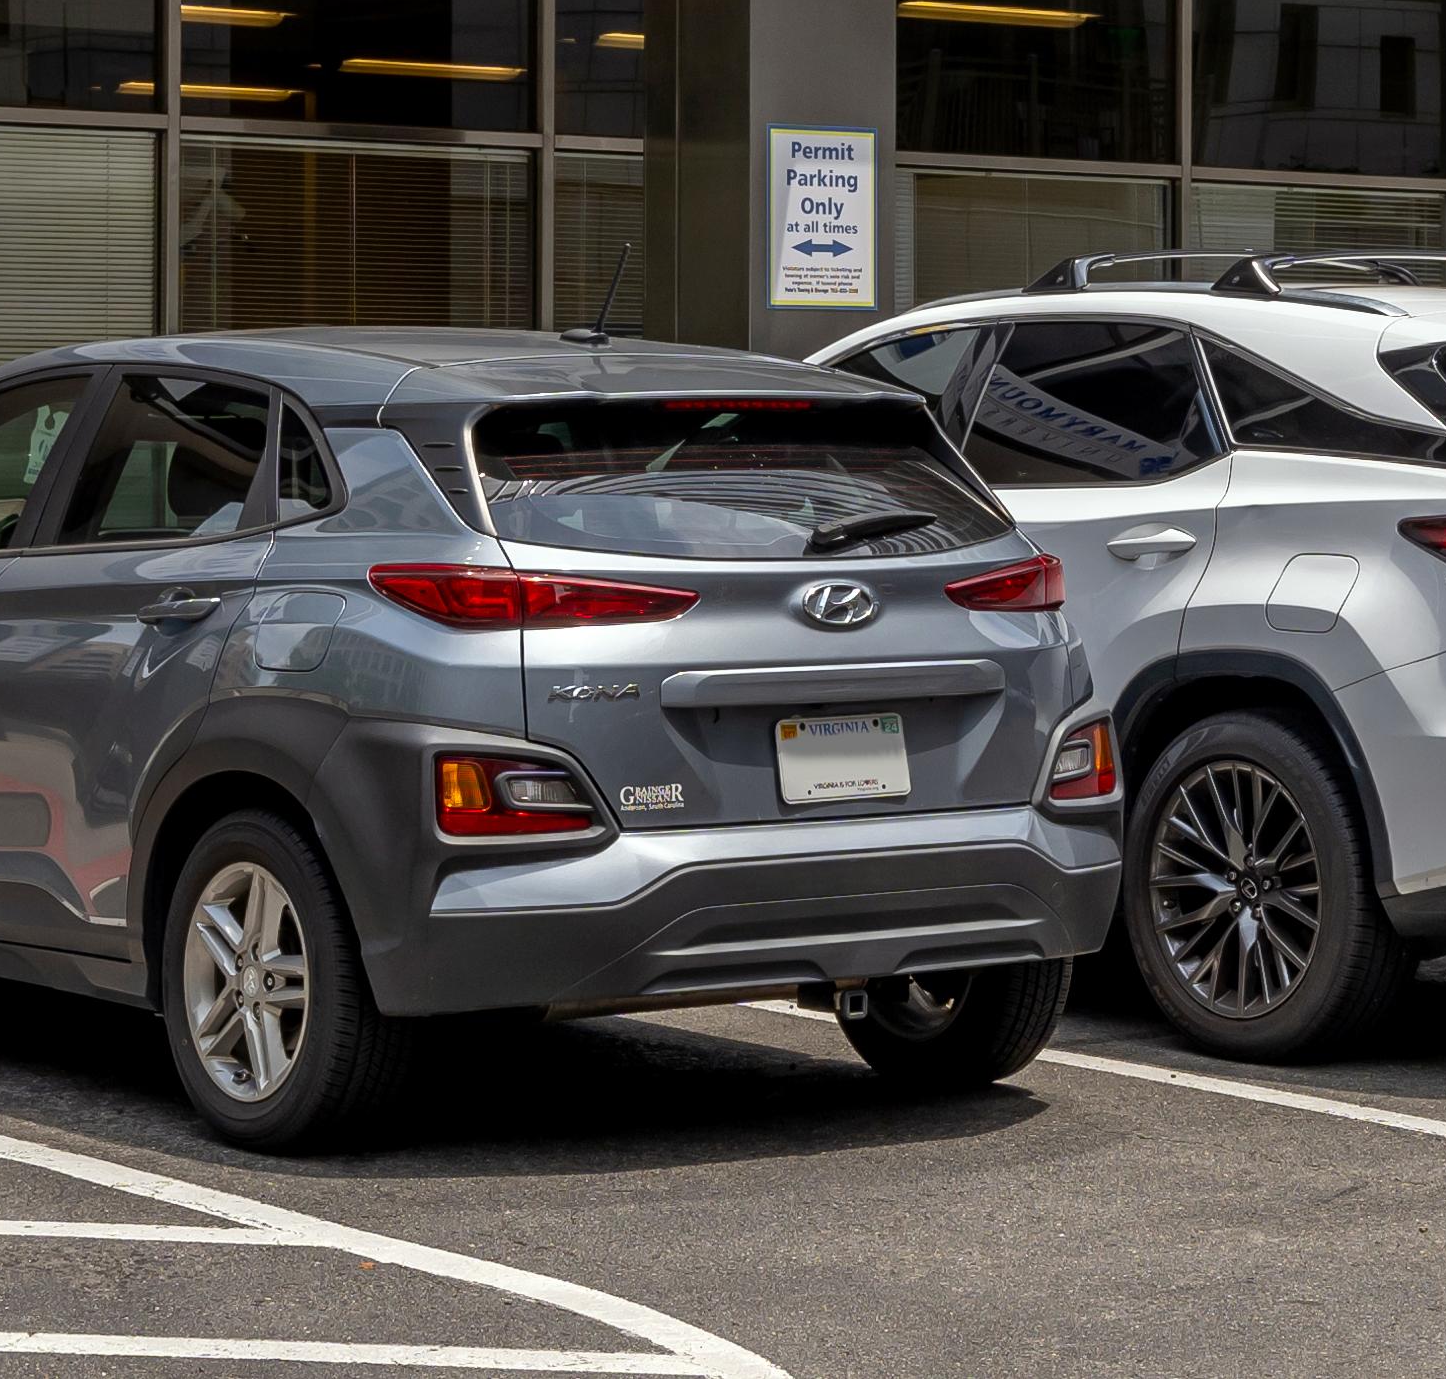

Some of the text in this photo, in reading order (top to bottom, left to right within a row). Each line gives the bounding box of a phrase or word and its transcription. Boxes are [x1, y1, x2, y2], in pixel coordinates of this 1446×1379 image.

[791, 141, 854, 161] Permit
[786, 169, 858, 192] Parking
[801, 197, 844, 220] Only
[787, 221, 858, 235] at all times
[548, 683, 641, 703] KONA
[808, 720, 869, 736] VIRGINIA
